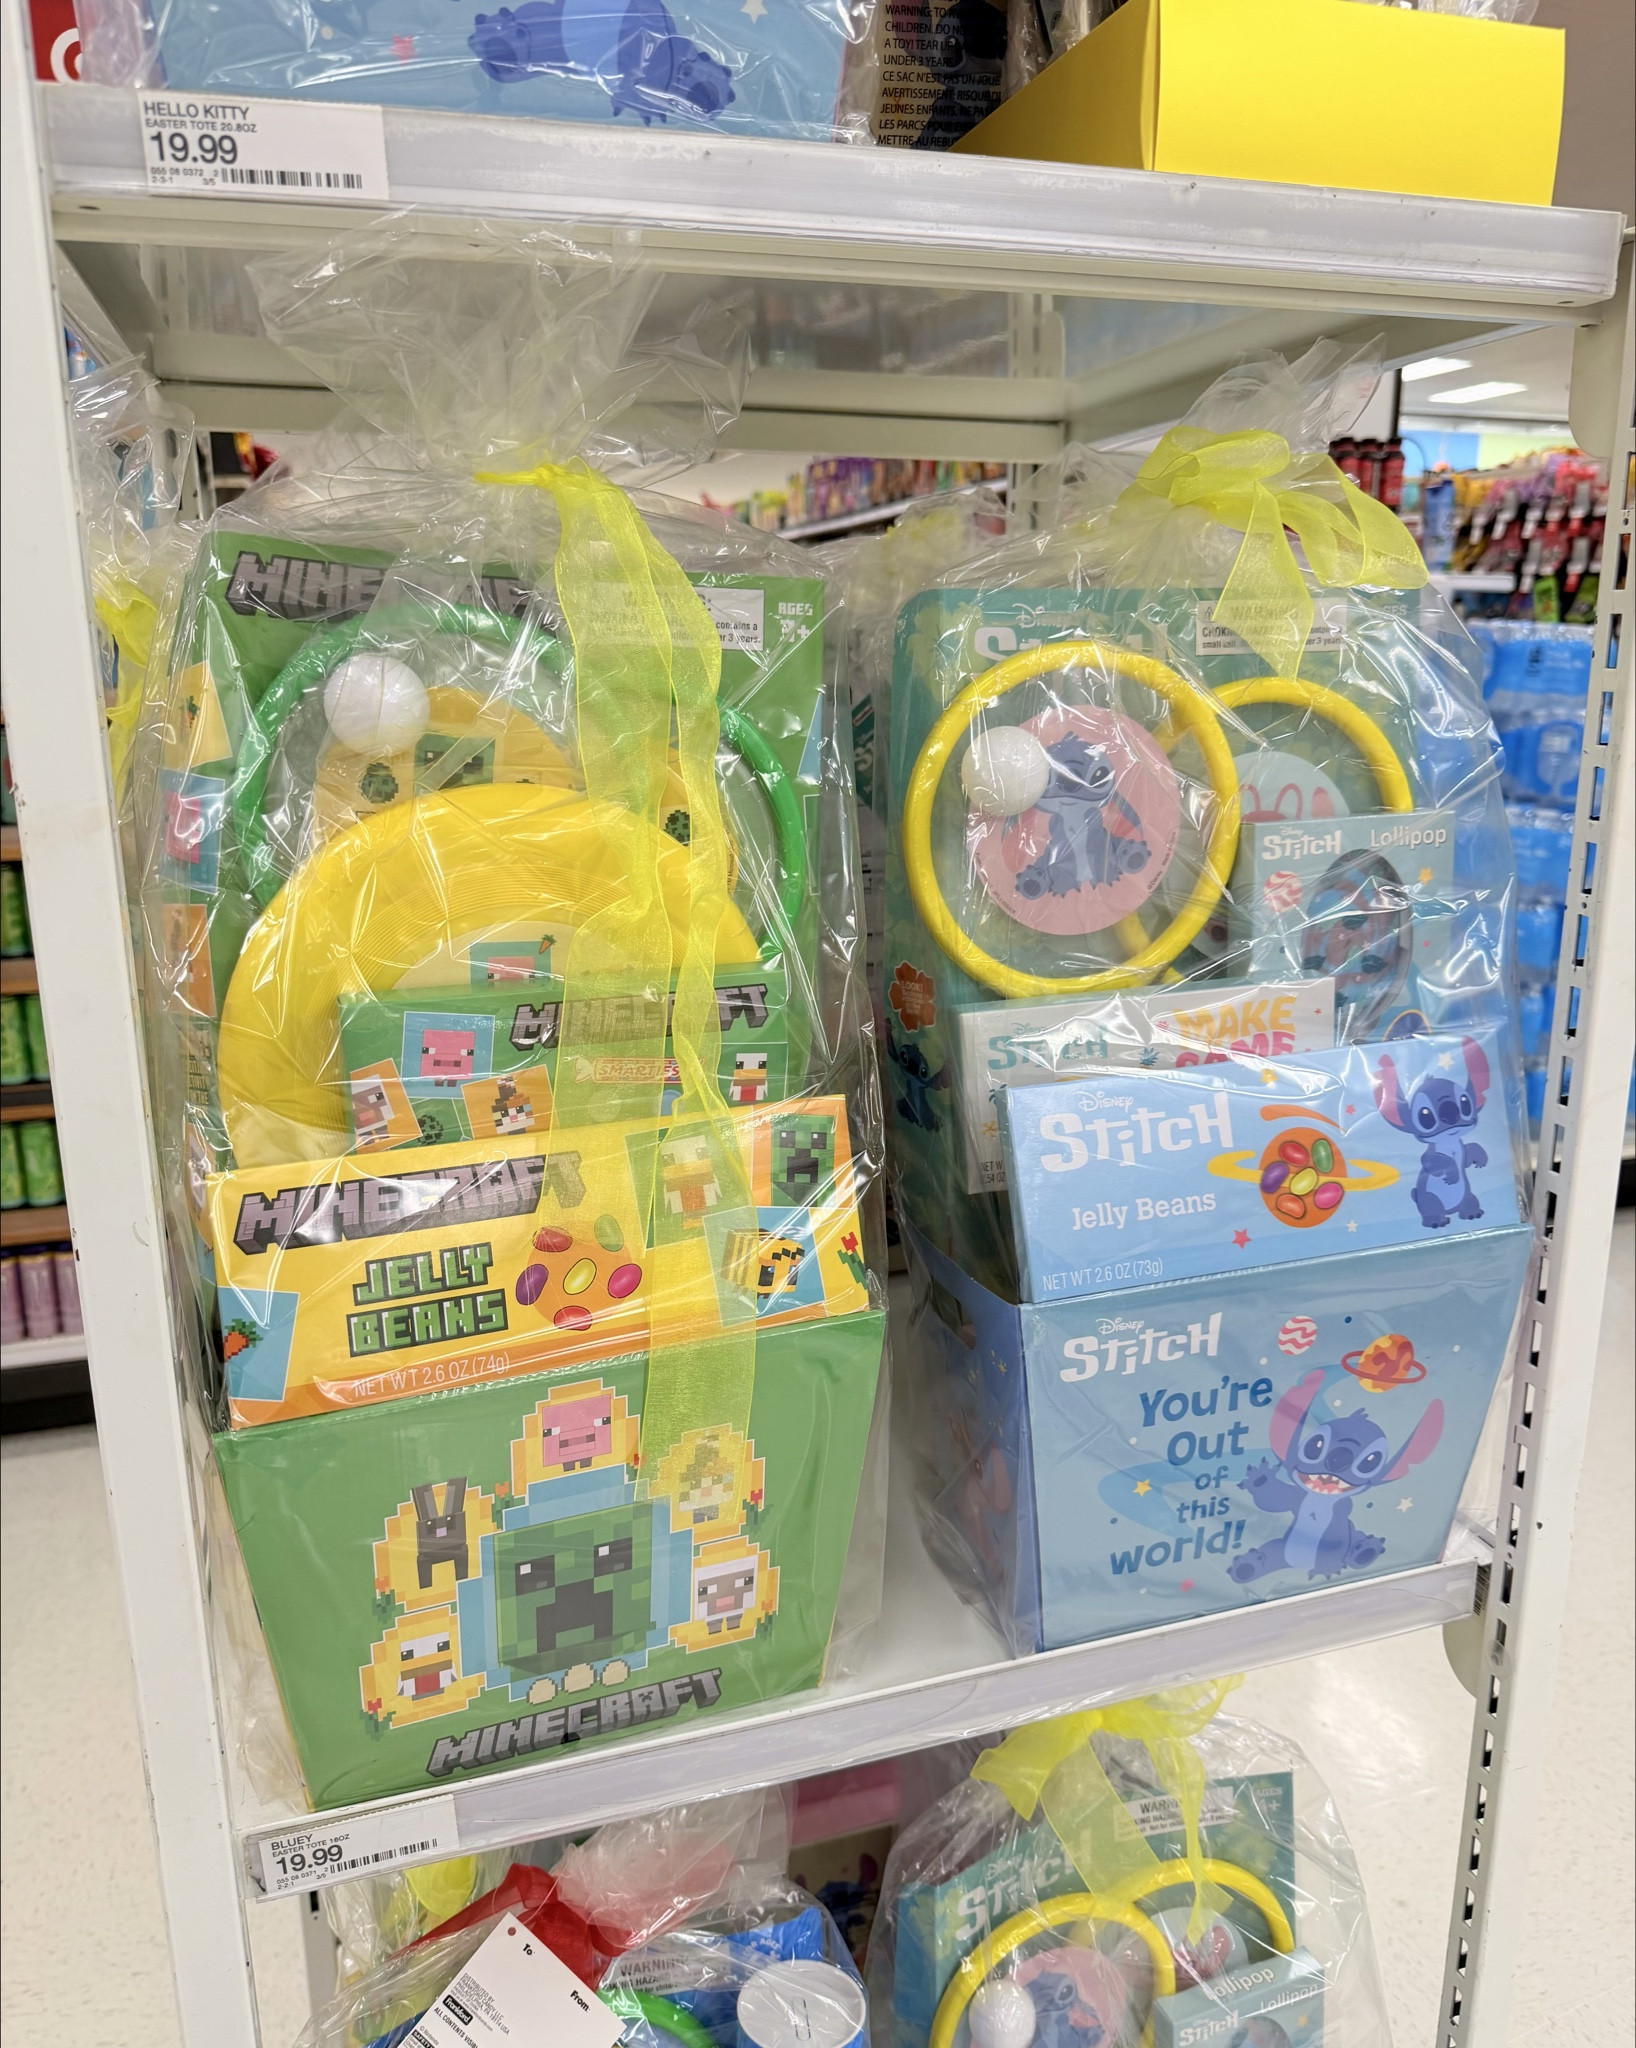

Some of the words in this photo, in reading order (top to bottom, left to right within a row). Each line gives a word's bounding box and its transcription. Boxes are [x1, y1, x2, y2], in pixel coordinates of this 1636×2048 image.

[935, 7, 946, 18] TO
[936, 24, 951, 35] DO
[884, 38, 891, 49] A
[916, 39, 939, 51] TEAR
[883, 54, 919, 67] UNDER
[918, 56, 924, 67] 3
[883, 71, 895, 82] CE
[896, 72, 915, 83] SAC
[916, 72, 941, 84] N'EST
[961, 74, 976, 85] UN
[143, 101, 199, 119] HELLO
[204, 104, 250, 121] KITTY
[880, 103, 915, 115] JEUNES
[145, 119, 188, 130] EASTER
[190, 120, 217, 132] TOTE
[220, 122, 257, 133] 20.8OZ
[878, 119, 895, 130] LES
[896, 120, 926, 131] PARCS
[150, 131, 239, 165] 19.99
[877, 134, 914, 146] METTRE
[915, 136, 929, 146] AU
[151, 166, 168, 175] 055
[170, 168, 181, 176] 08
[182, 168, 204, 177] 0372
[213, 169, 219, 177] 2
[152, 175, 174, 184] 2-3-1
[202, 178, 216, 187] 3/5
[778, 601, 814, 617] AGES
[728, 633, 734, 642] 3
[752, 623, 758, 631] a
[1369, 826, 1447, 850] Lollipop
[509, 982, 769, 1052] MINECRAFT
[1171, 996, 1297, 1050] MAKE
[596, 1059, 681, 1082] SMARTIES
[1075, 1091, 1134, 1113] Disney
[233, 1149, 588, 1256] MINECRAFT
[1071, 1203, 1129, 1231] Jelly
[1135, 1193, 1217, 1222] Beans
[352, 1241, 494, 1306] JELLY
[1042, 1272, 1068, 1292] NET
[1071, 1268, 1091, 1287] WT
[1094, 1265, 1112, 1285] 2.6
[1115, 1262, 1132, 1280] OZ
[1133, 1257, 1164, 1279] (73g)
[346, 1288, 510, 1358] BEANS
[1095, 1317, 1145, 1335] Disney
[353, 1375, 385, 1397] NET
[389, 1371, 419, 1392] WT
[422, 1366, 446, 1387] 2.6
[448, 1361, 470, 1383] OZ
[472, 1352, 511, 1379] (74g)
[1138, 1375, 1273, 1428] You're
[1166, 1421, 1249, 1466] Out
[1194, 1464, 1229, 1490] of
[1176, 1496, 1230, 1523] this
[1110, 1518, 1247, 1575] world!
[425, 1667, 723, 1778] MINECRAFT
[270, 1834, 314, 1851] BLUEY
[272, 1844, 305, 1858] EASTER
[305, 1839, 327, 1851] TOTE
[329, 1833, 350, 1844] 16OZ
[276, 1844, 344, 1875] 19.99
[276, 1876, 290, 1885] 055
[290, 1874, 300, 1882] 08
[300, 1869, 317, 1880] 0371
[277, 1881, 295, 1890] 2-2-1
[316, 1872, 327, 1880] 3/5
[569, 1989, 592, 2013] From:
[434, 2007, 444, 2018] ALL
[442, 2013, 466, 2038] CONTENTS
